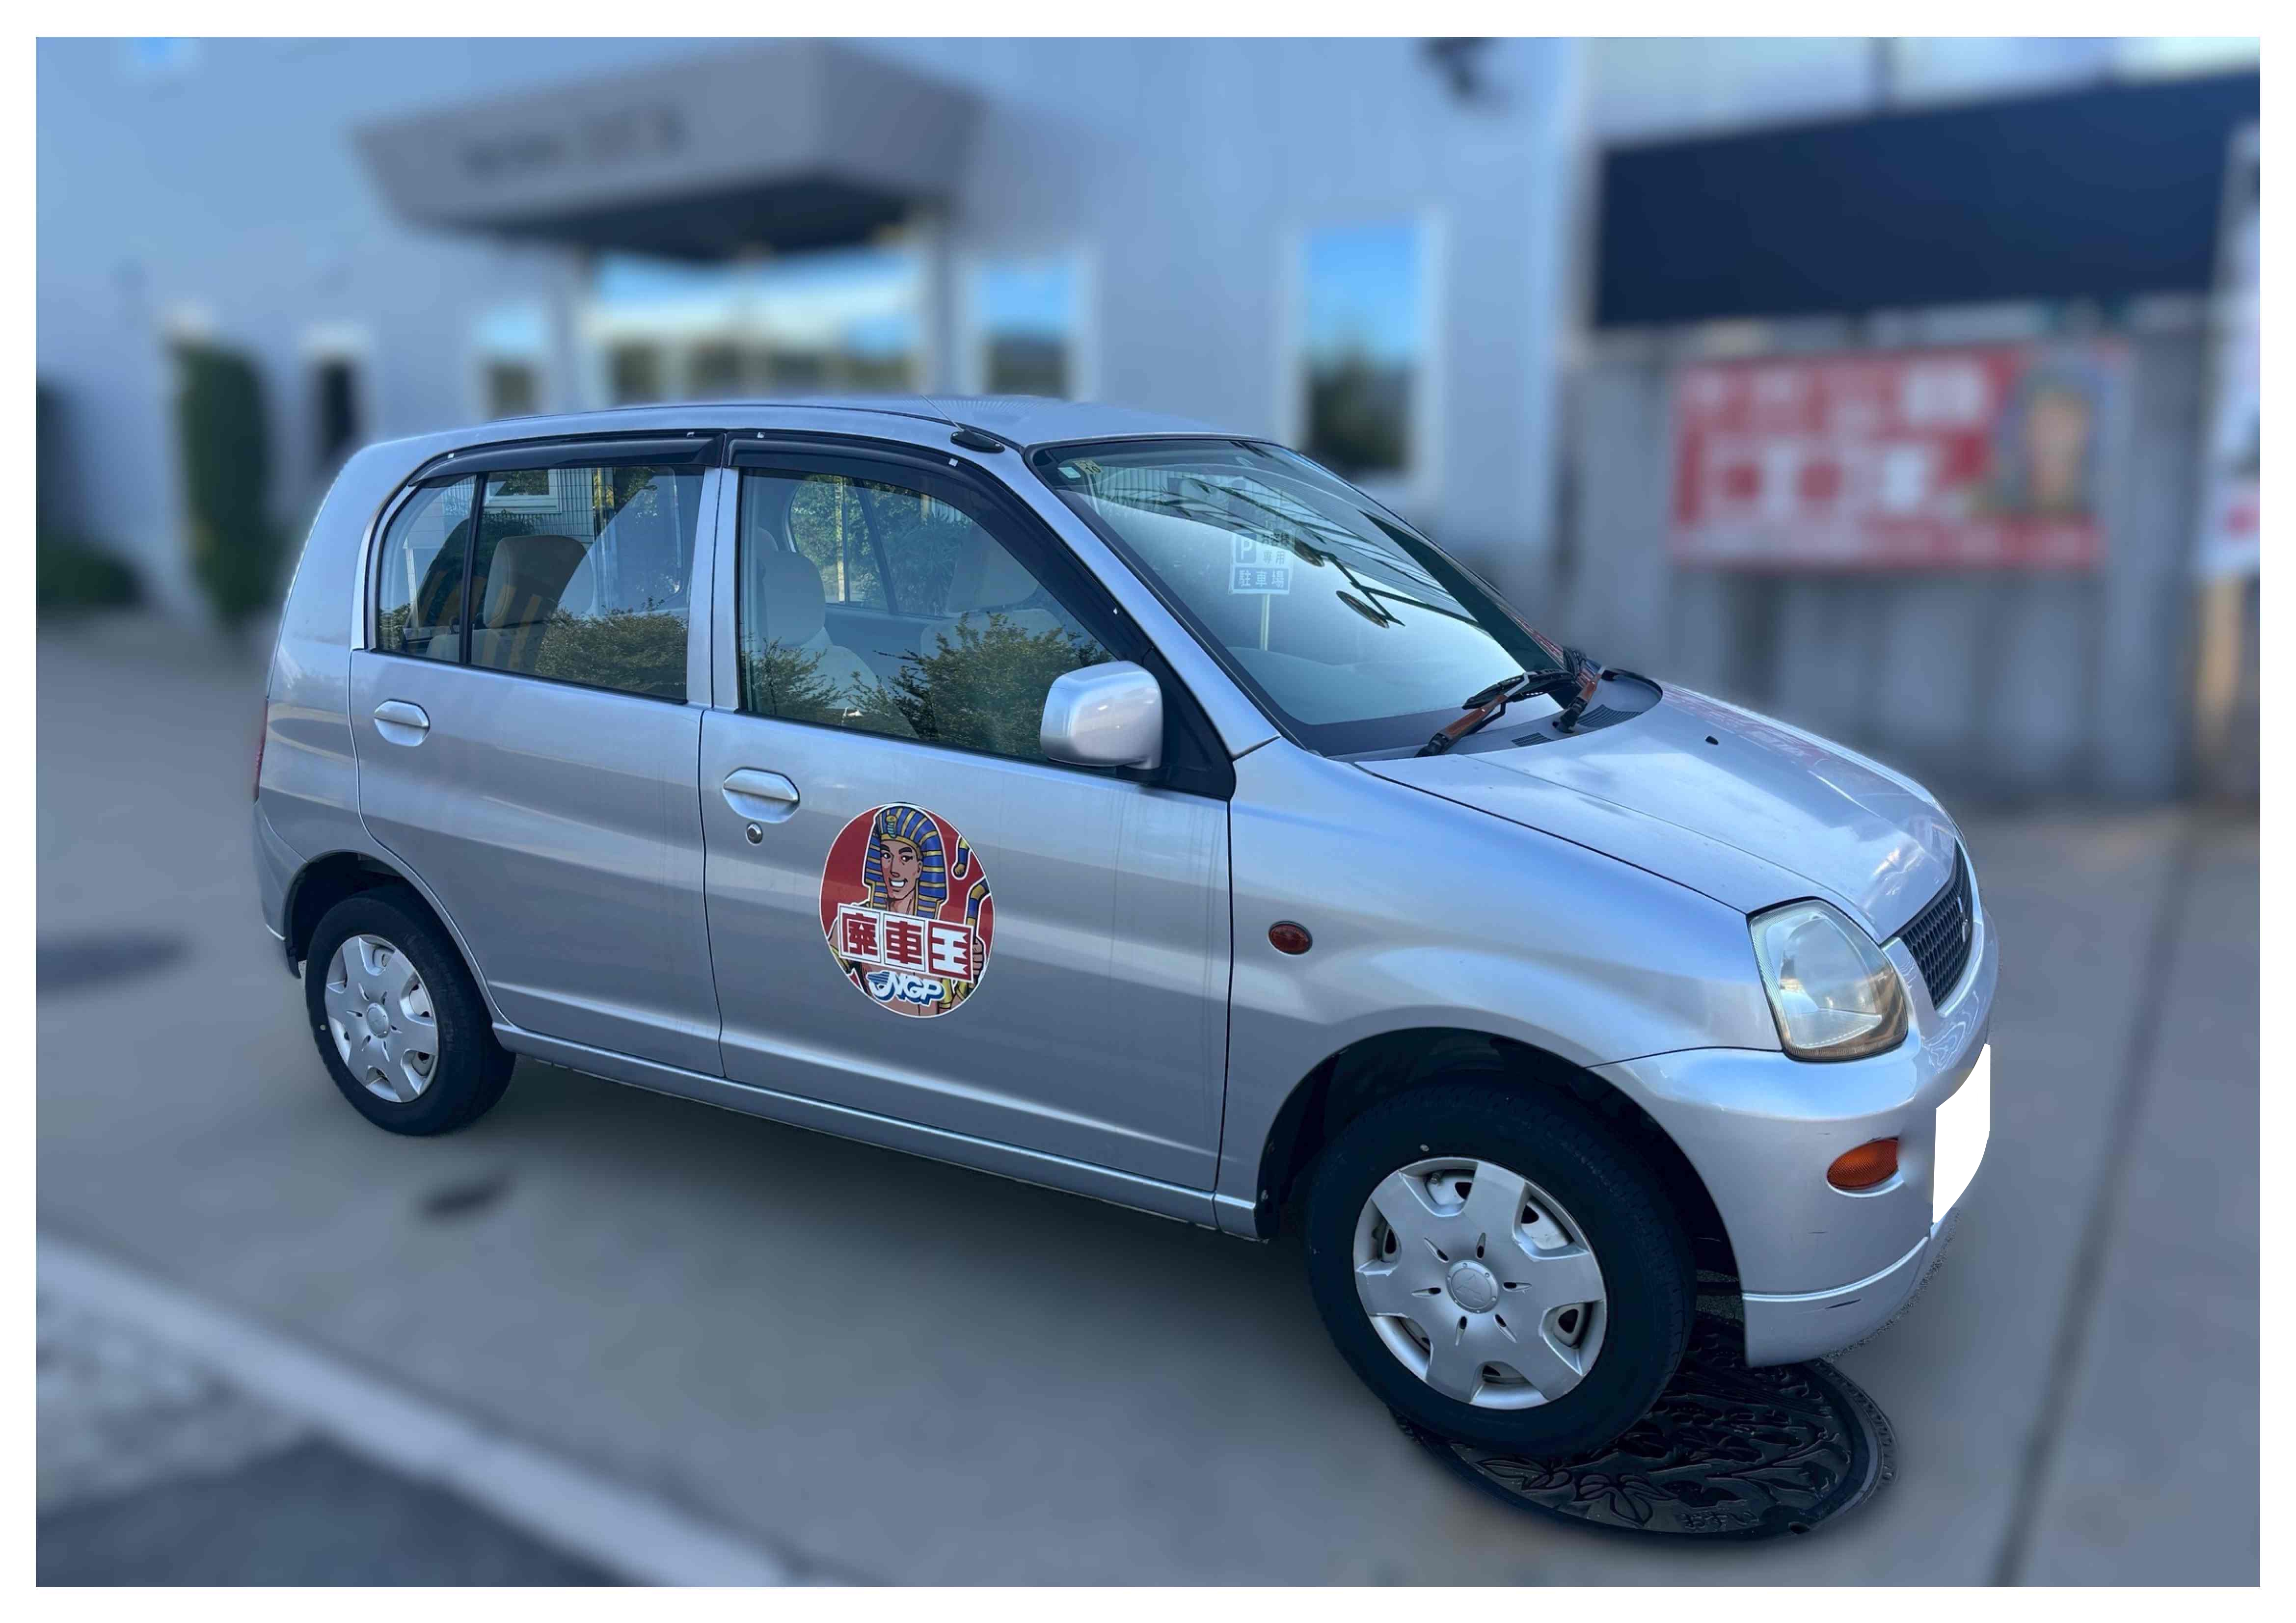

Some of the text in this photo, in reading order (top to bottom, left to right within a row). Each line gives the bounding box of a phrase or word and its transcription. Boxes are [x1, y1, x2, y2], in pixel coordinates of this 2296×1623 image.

[1241, 538, 1252, 560] P
[1263, 550, 1285, 565] 専用
[1238, 569, 1285, 588] 駐車場
[841, 911, 971, 977] 廃車王
[867, 971, 945, 1006] NGP
